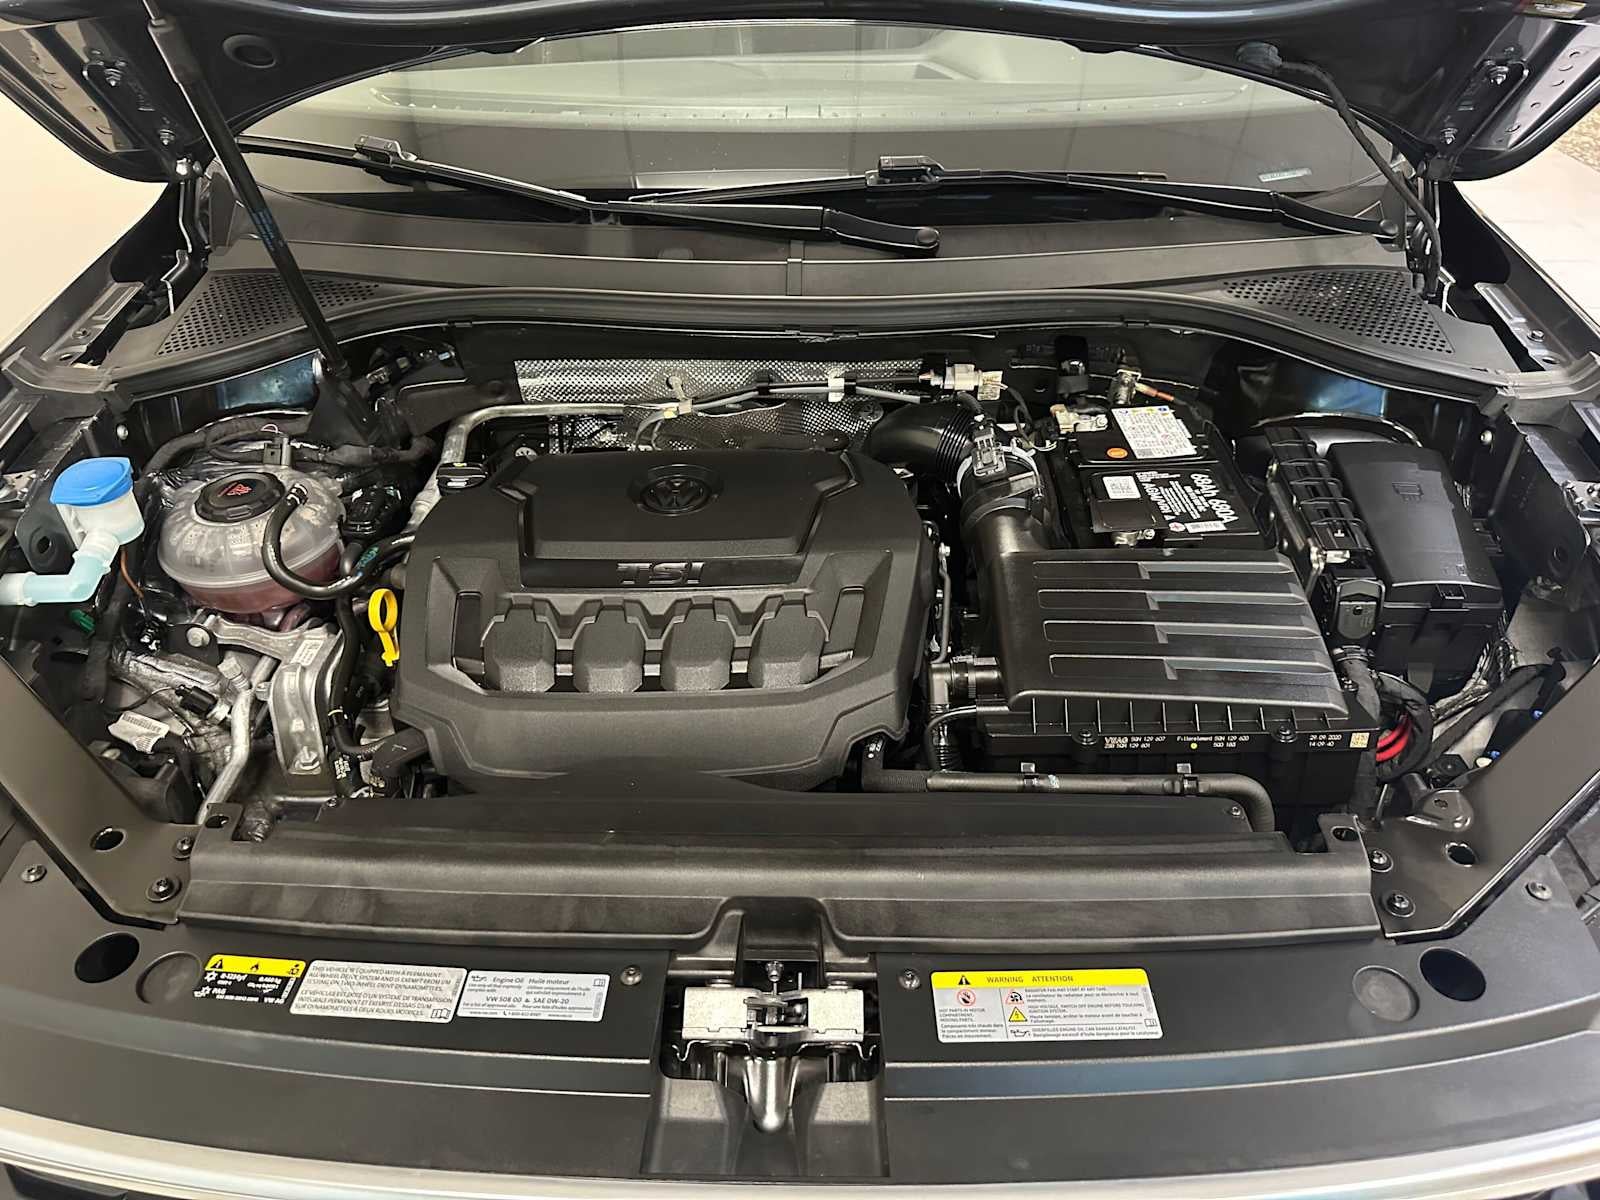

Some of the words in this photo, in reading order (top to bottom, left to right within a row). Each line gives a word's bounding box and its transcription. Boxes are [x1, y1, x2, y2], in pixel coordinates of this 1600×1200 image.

[1190, 473, 1220, 497] 68Ah
[1208, 499, 1239, 524] 680A
[617, 562, 706, 585] TSI
[493, 976, 514, 984] Engine
